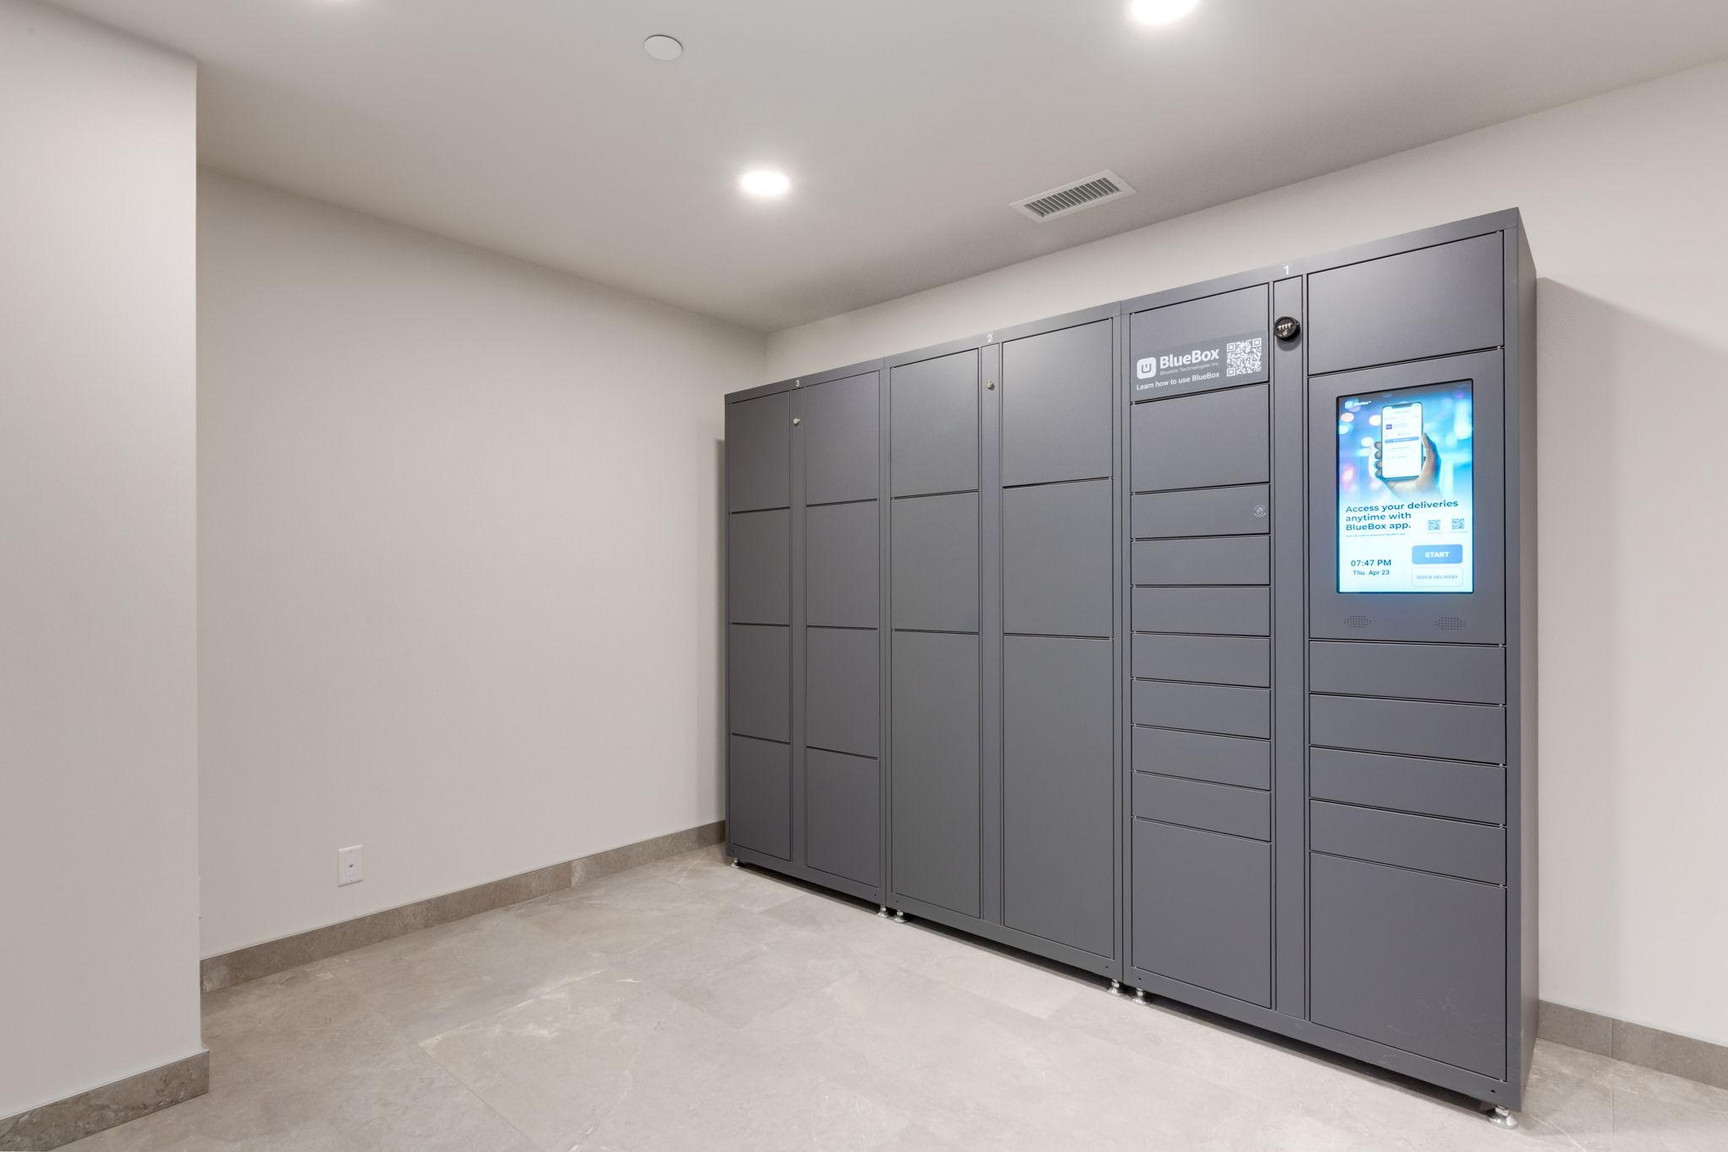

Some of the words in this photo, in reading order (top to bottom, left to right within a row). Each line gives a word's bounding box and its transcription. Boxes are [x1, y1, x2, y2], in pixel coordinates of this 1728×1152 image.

[1283, 265, 1289, 275] 1
[987, 334, 993, 343] 2
[1160, 349, 1220, 369] BlueBox
[795, 379, 800, 387] 3
[1136, 383, 1154, 391] Learn
[1191, 372, 1220, 382] BlueBox
[1345, 504, 1380, 513] Access
[1382, 503, 1404, 512] your
[1407, 499, 1459, 510] deliveries
[1345, 513, 1386, 523] anytime
[1388, 512, 1412, 520] with
[1345, 522, 1387, 531] BlueBox
[1389, 522, 1411, 531] app.
[1424, 551, 1450, 559] START
[1350, 559, 1375, 567] 07:47
[1368, 569, 1380, 577] Apr
